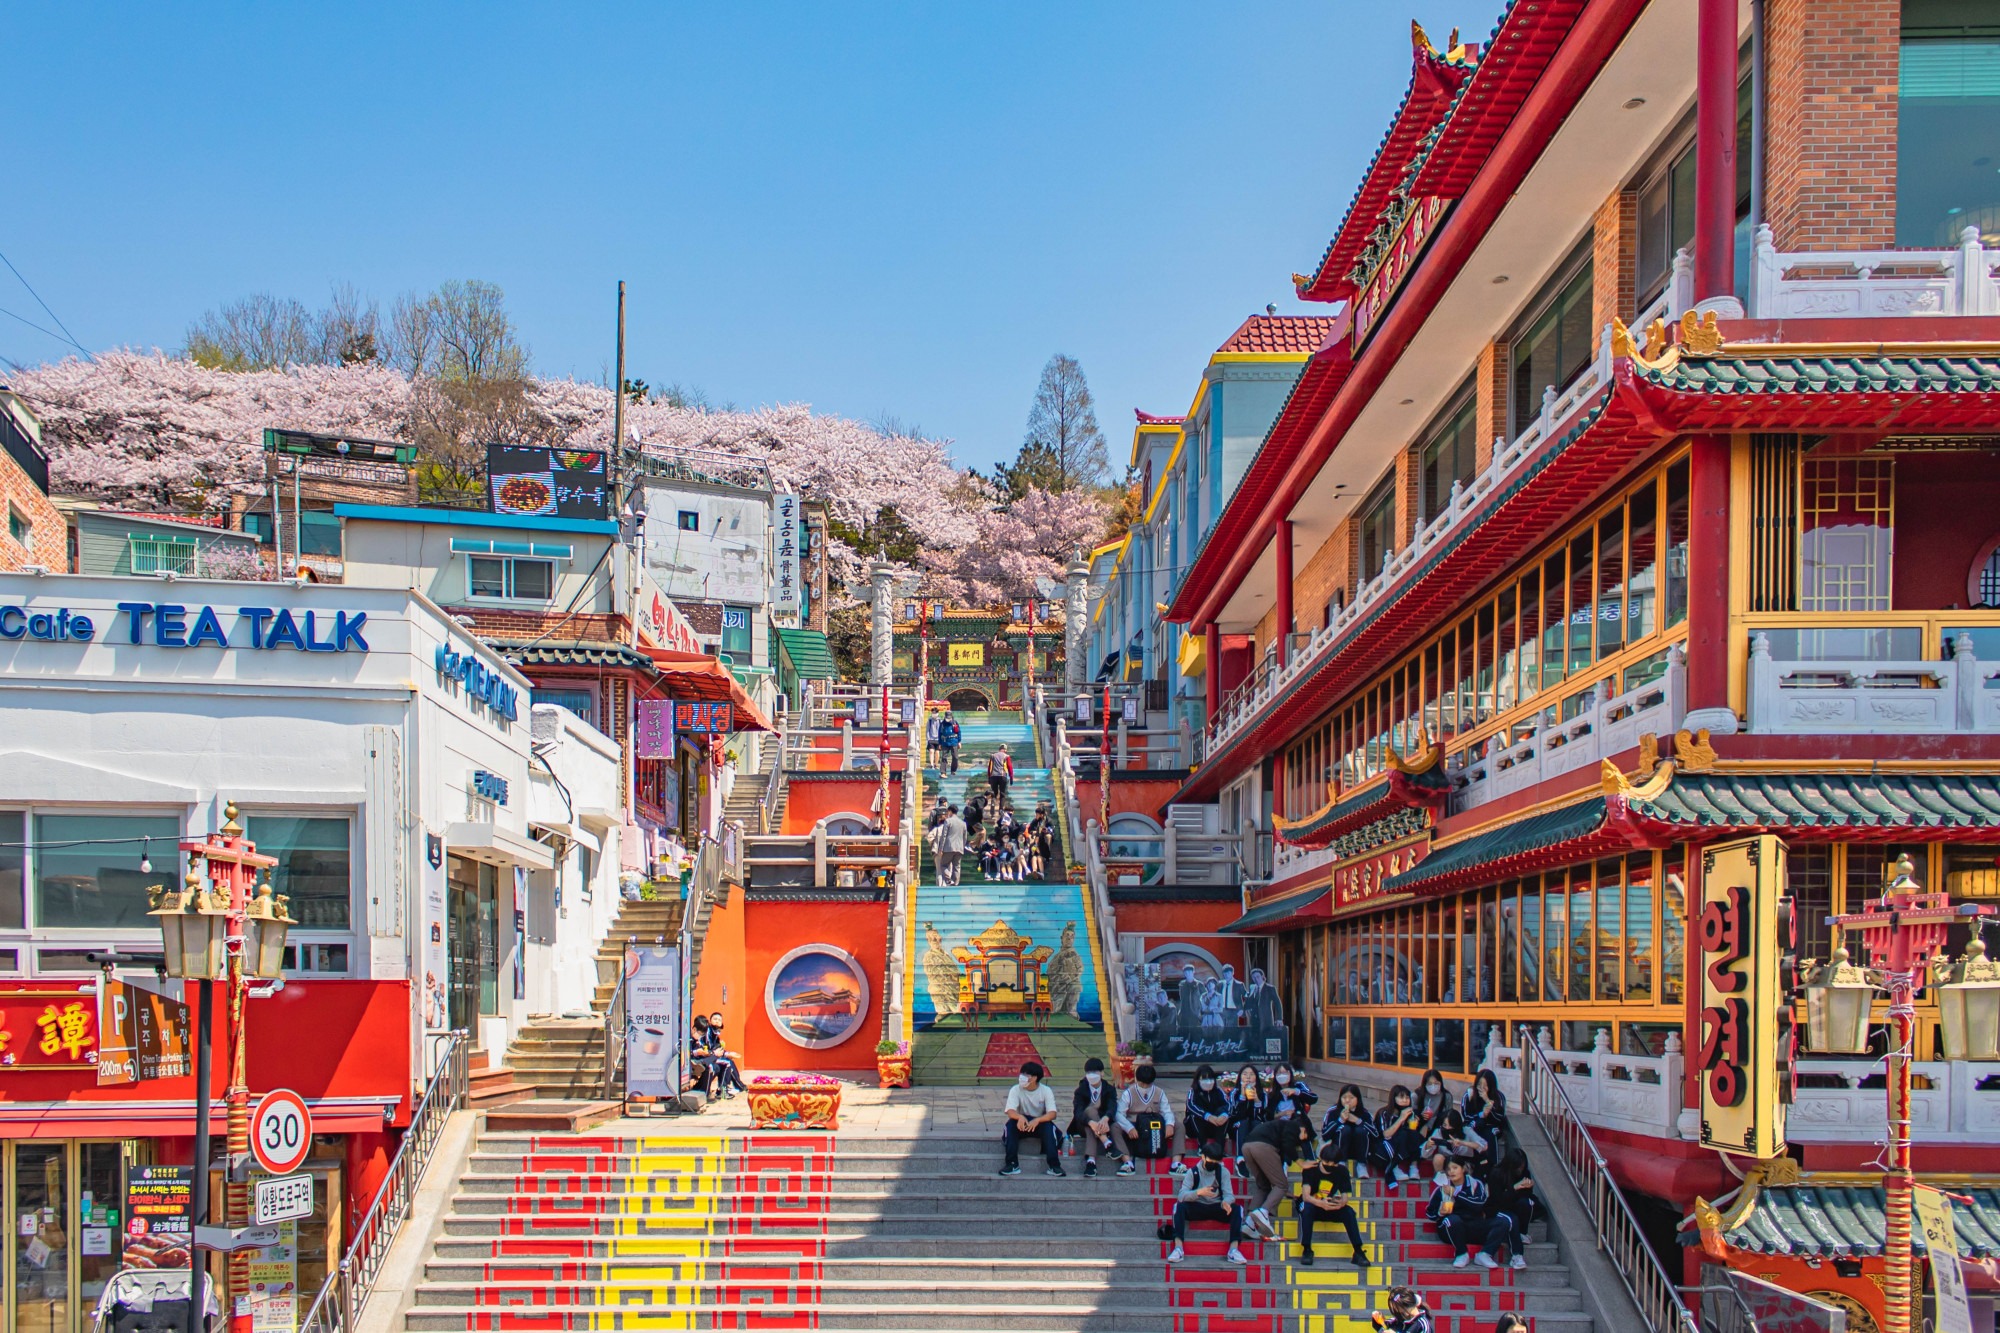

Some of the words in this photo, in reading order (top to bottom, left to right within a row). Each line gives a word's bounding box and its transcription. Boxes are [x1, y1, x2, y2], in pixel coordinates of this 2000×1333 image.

[779, 498, 794, 556] 골동품
[0, 604, 95, 641] Cafe
[117, 602, 228, 648] TEA
[238, 607, 370, 653] TALK
[677, 704, 730, 731] 만사성
[112, 995, 128, 1036] P
[1698, 886, 1748, 1108] 연경
[636, 1014, 670, 1025] 연경할인
[101, 1061, 122, 1076] 200m
[265, 1113, 298, 1150] 30
[260, 1181, 310, 1217] 생활도로구역
